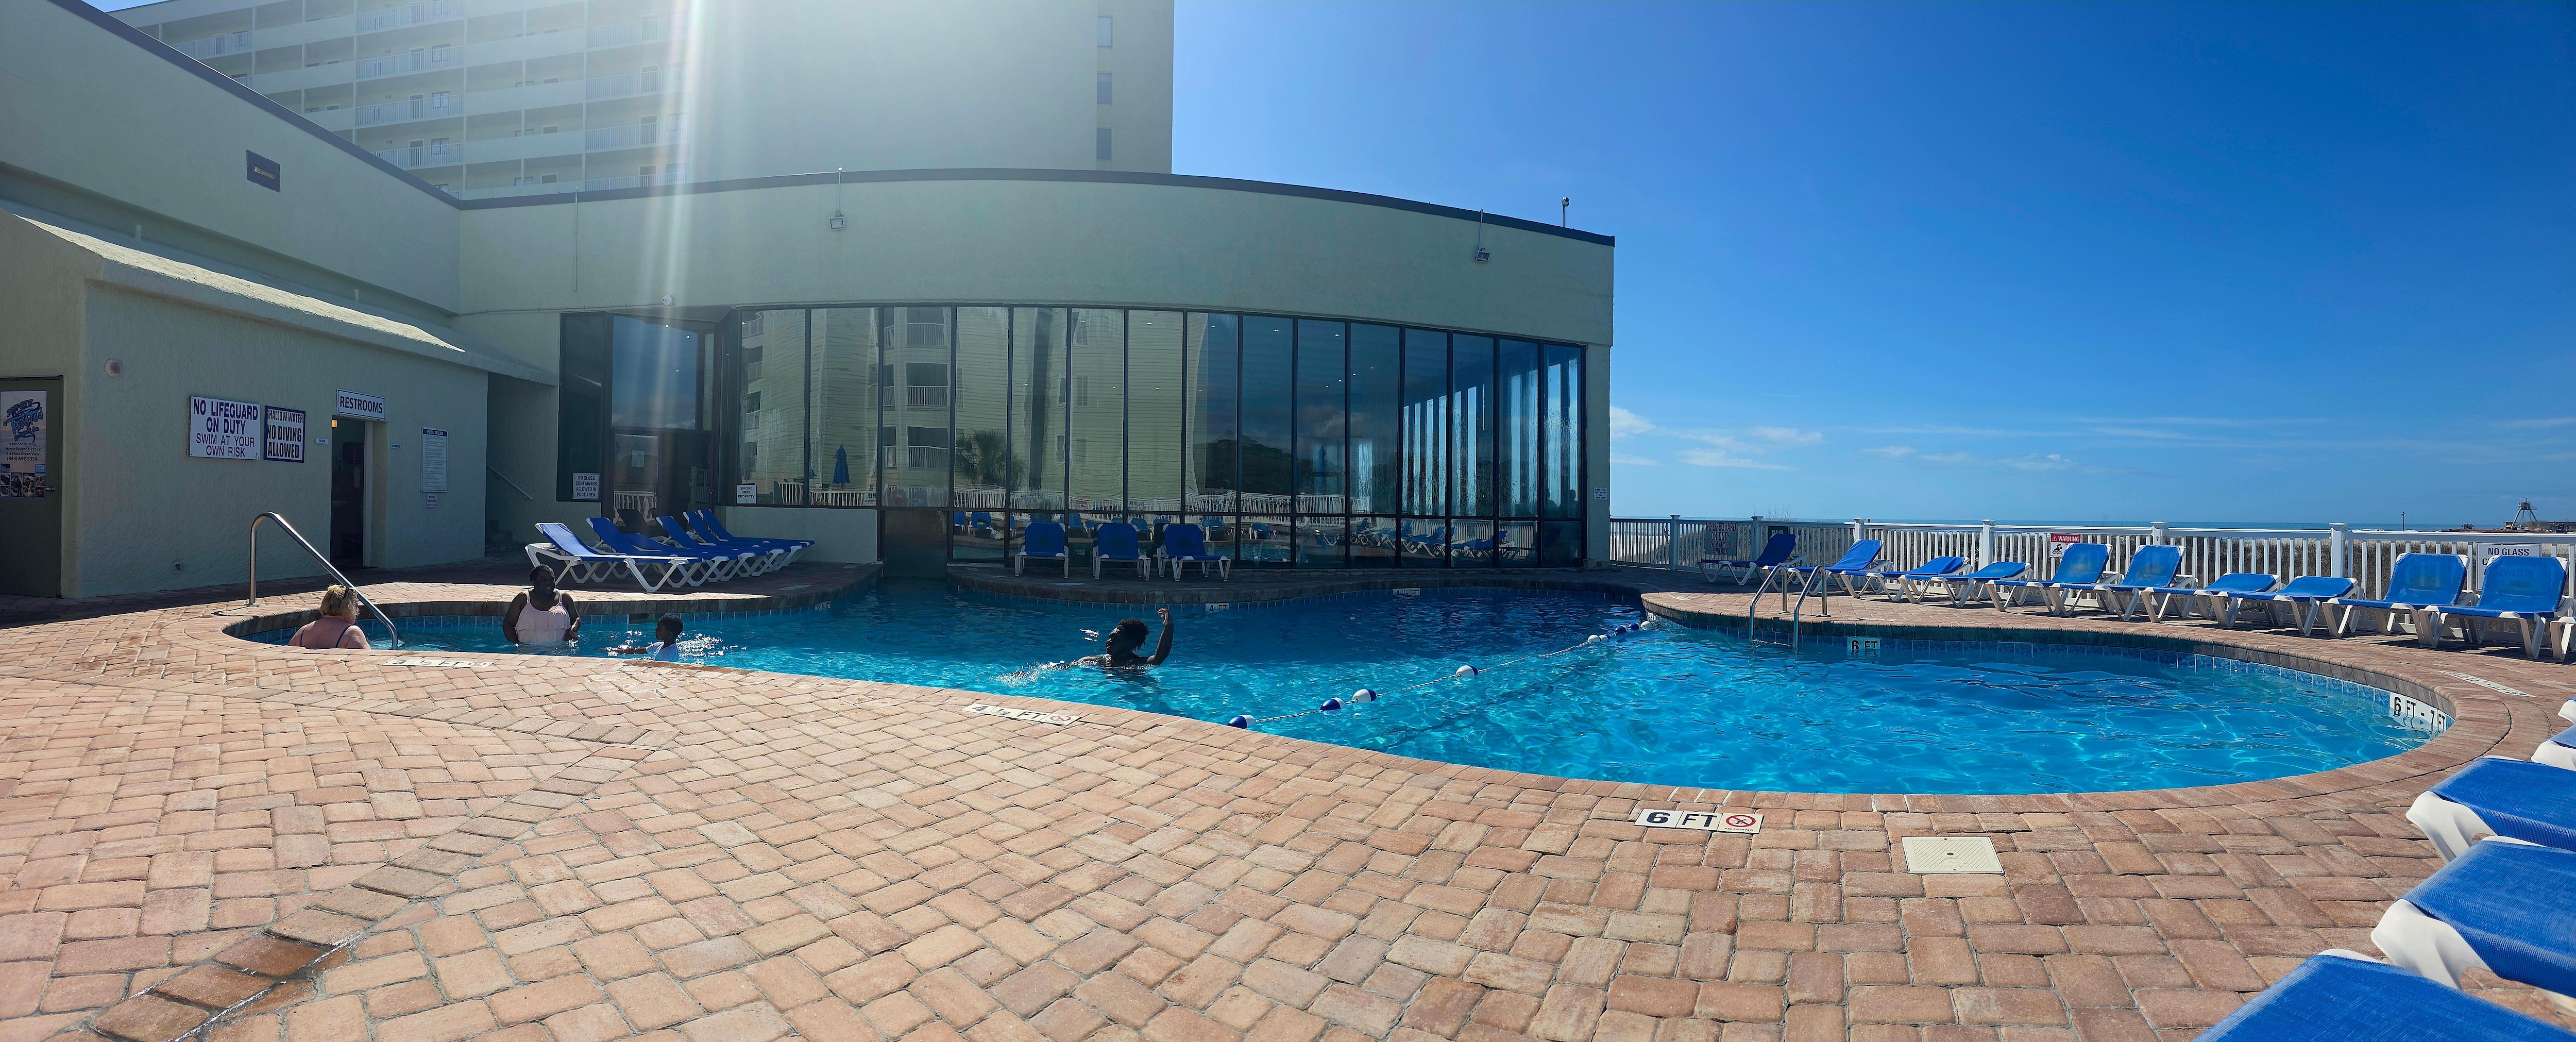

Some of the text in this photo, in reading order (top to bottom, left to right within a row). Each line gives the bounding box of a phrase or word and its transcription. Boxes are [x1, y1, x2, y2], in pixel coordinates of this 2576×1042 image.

[193, 399, 258, 421] NO LIFEGUARD
[340, 396, 383, 414] RESTROOMS
[267, 409, 303, 424] SHALLOW WATER
[206, 416, 246, 435] ON DUTY
[196, 433, 255, 447] SWIM AT YOUR
[267, 424, 302, 443] NO DIVING
[206, 445, 246, 457] OWN RISK
[267, 442, 300, 458] ALLOWED
[1706, 522, 1736, 531] NO LIFEGUARD
[1711, 532, 1730, 541] ON DUTY
[2502, 548, 2530, 556] GLASS
[1851, 640, 1859, 650] 6
[2394, 697, 2401, 712] 6
[2406, 700, 2416, 718] FT
[2430, 709, 2435, 730] 7
[2438, 713, 2446, 732] FT
[1646, 812, 1718, 827] 6 FT
